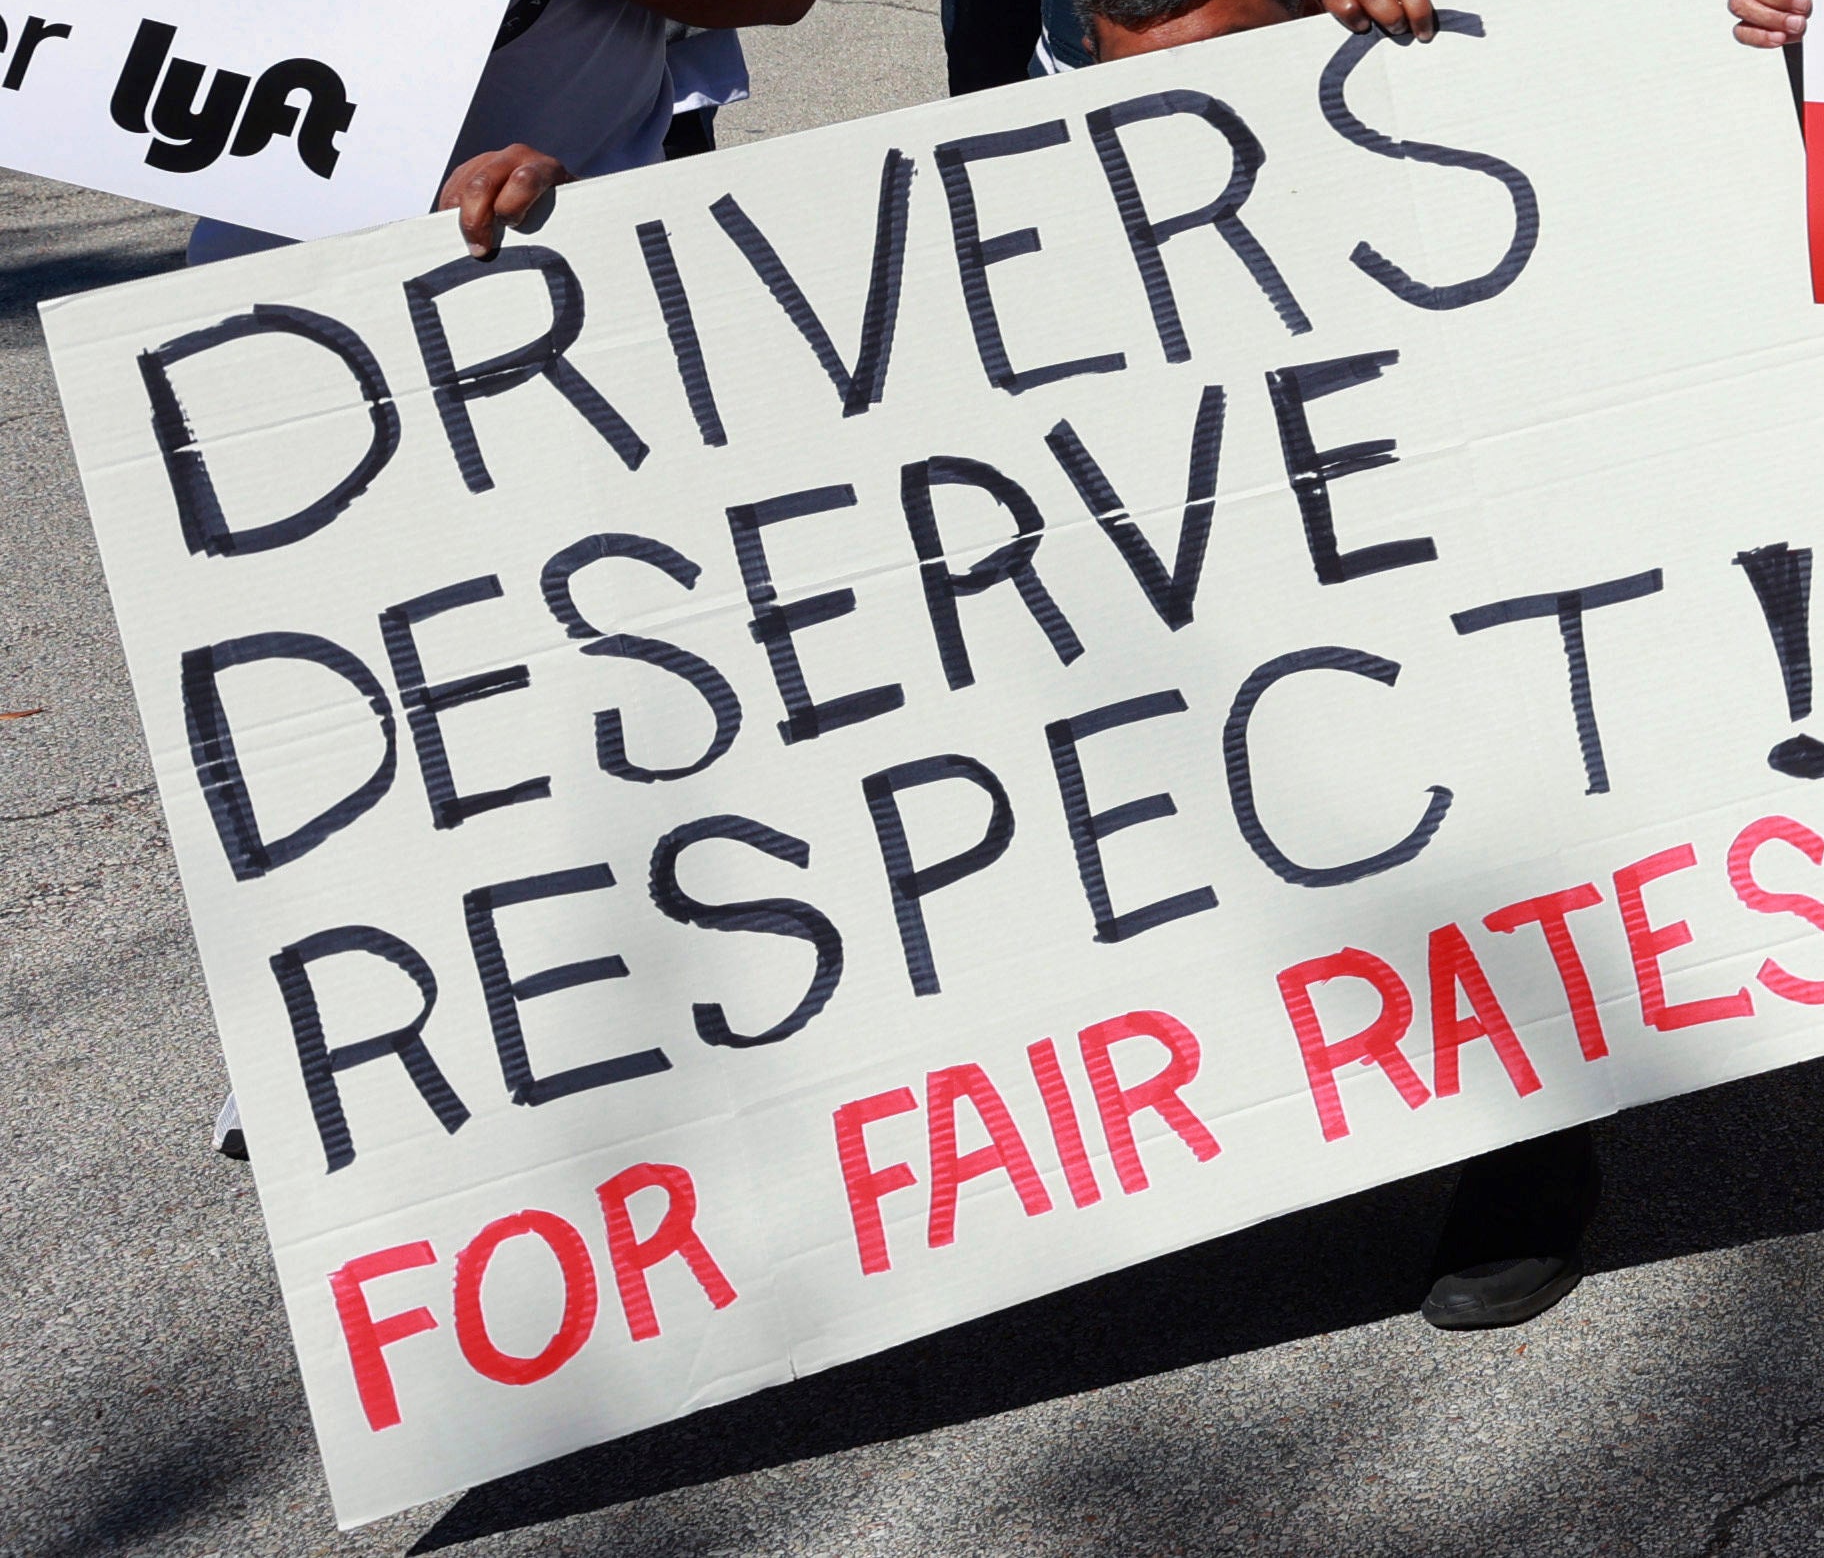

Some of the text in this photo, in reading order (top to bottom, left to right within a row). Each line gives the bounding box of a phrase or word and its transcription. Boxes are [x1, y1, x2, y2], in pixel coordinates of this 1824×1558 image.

[110, 17, 358, 180] lyft
[136, 7, 1542, 561] DRIVERS
[179, 347, 1443, 880] DESERVE
[327, 1160, 738, 1433] FOR
[831, 1007, 1222, 1277] FAIR
